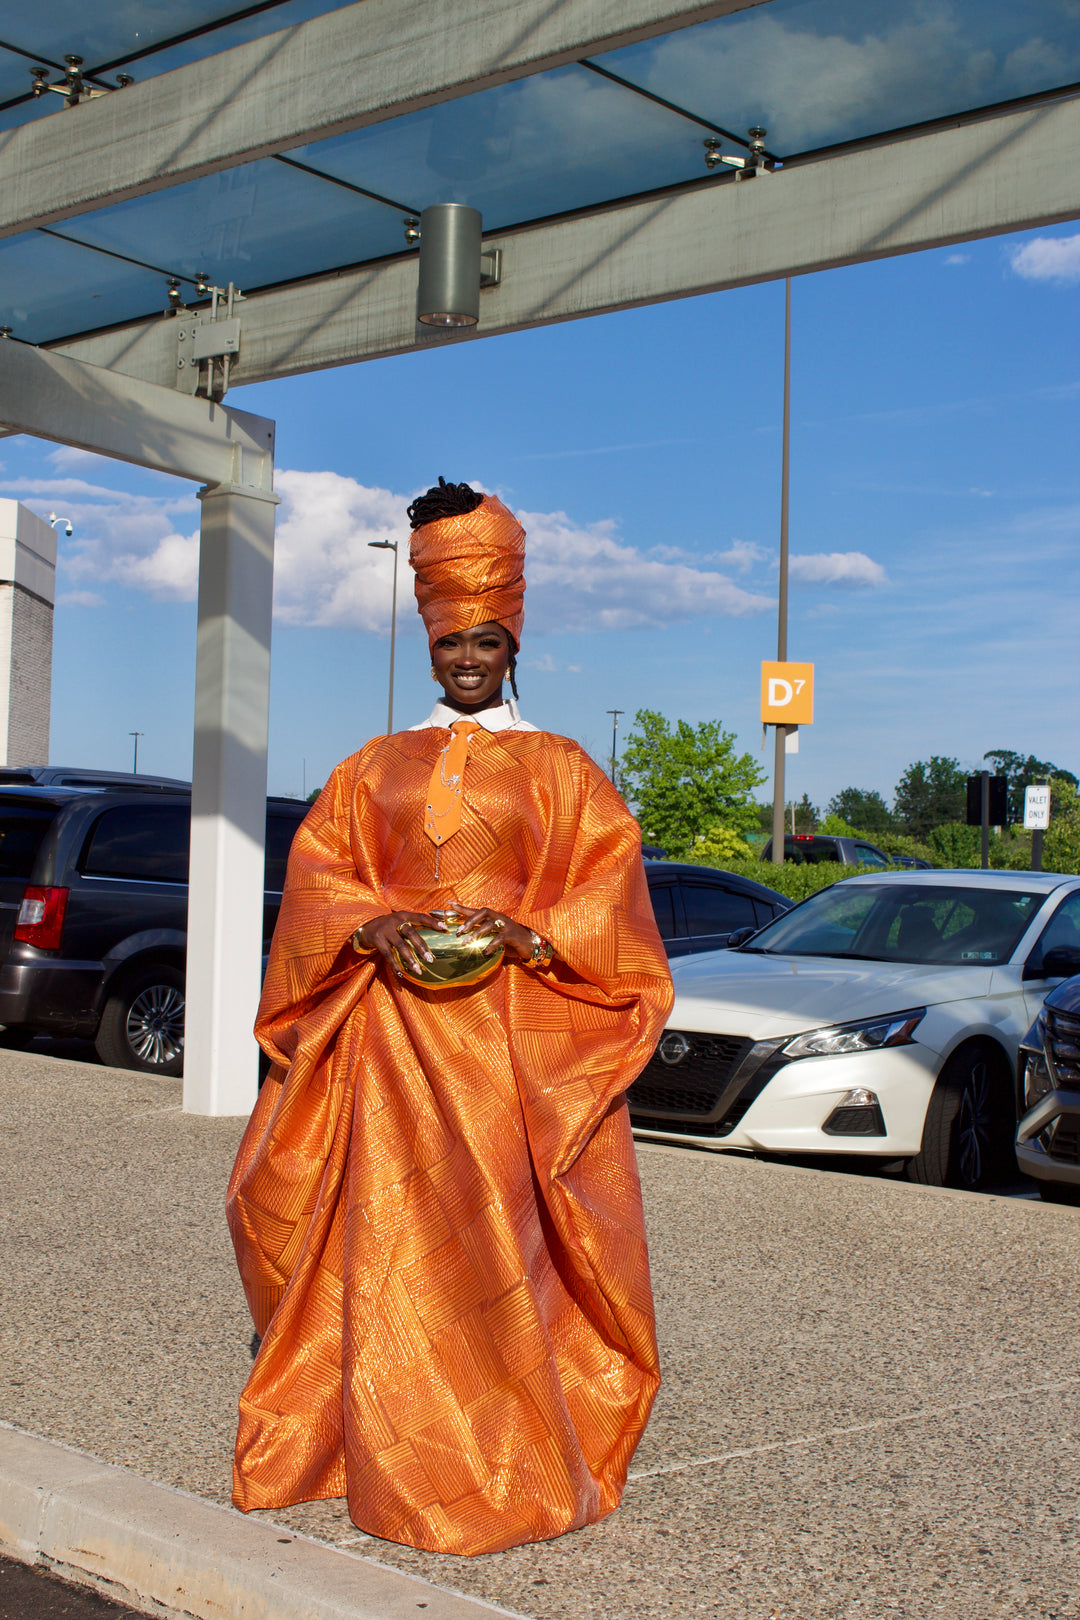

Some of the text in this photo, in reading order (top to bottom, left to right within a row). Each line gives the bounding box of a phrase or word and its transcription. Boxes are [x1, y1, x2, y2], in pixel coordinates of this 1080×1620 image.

[768, 678, 806, 707] D7
[1028, 796, 1047, 804] VALET
[1028, 810, 1045, 819] ONLY
